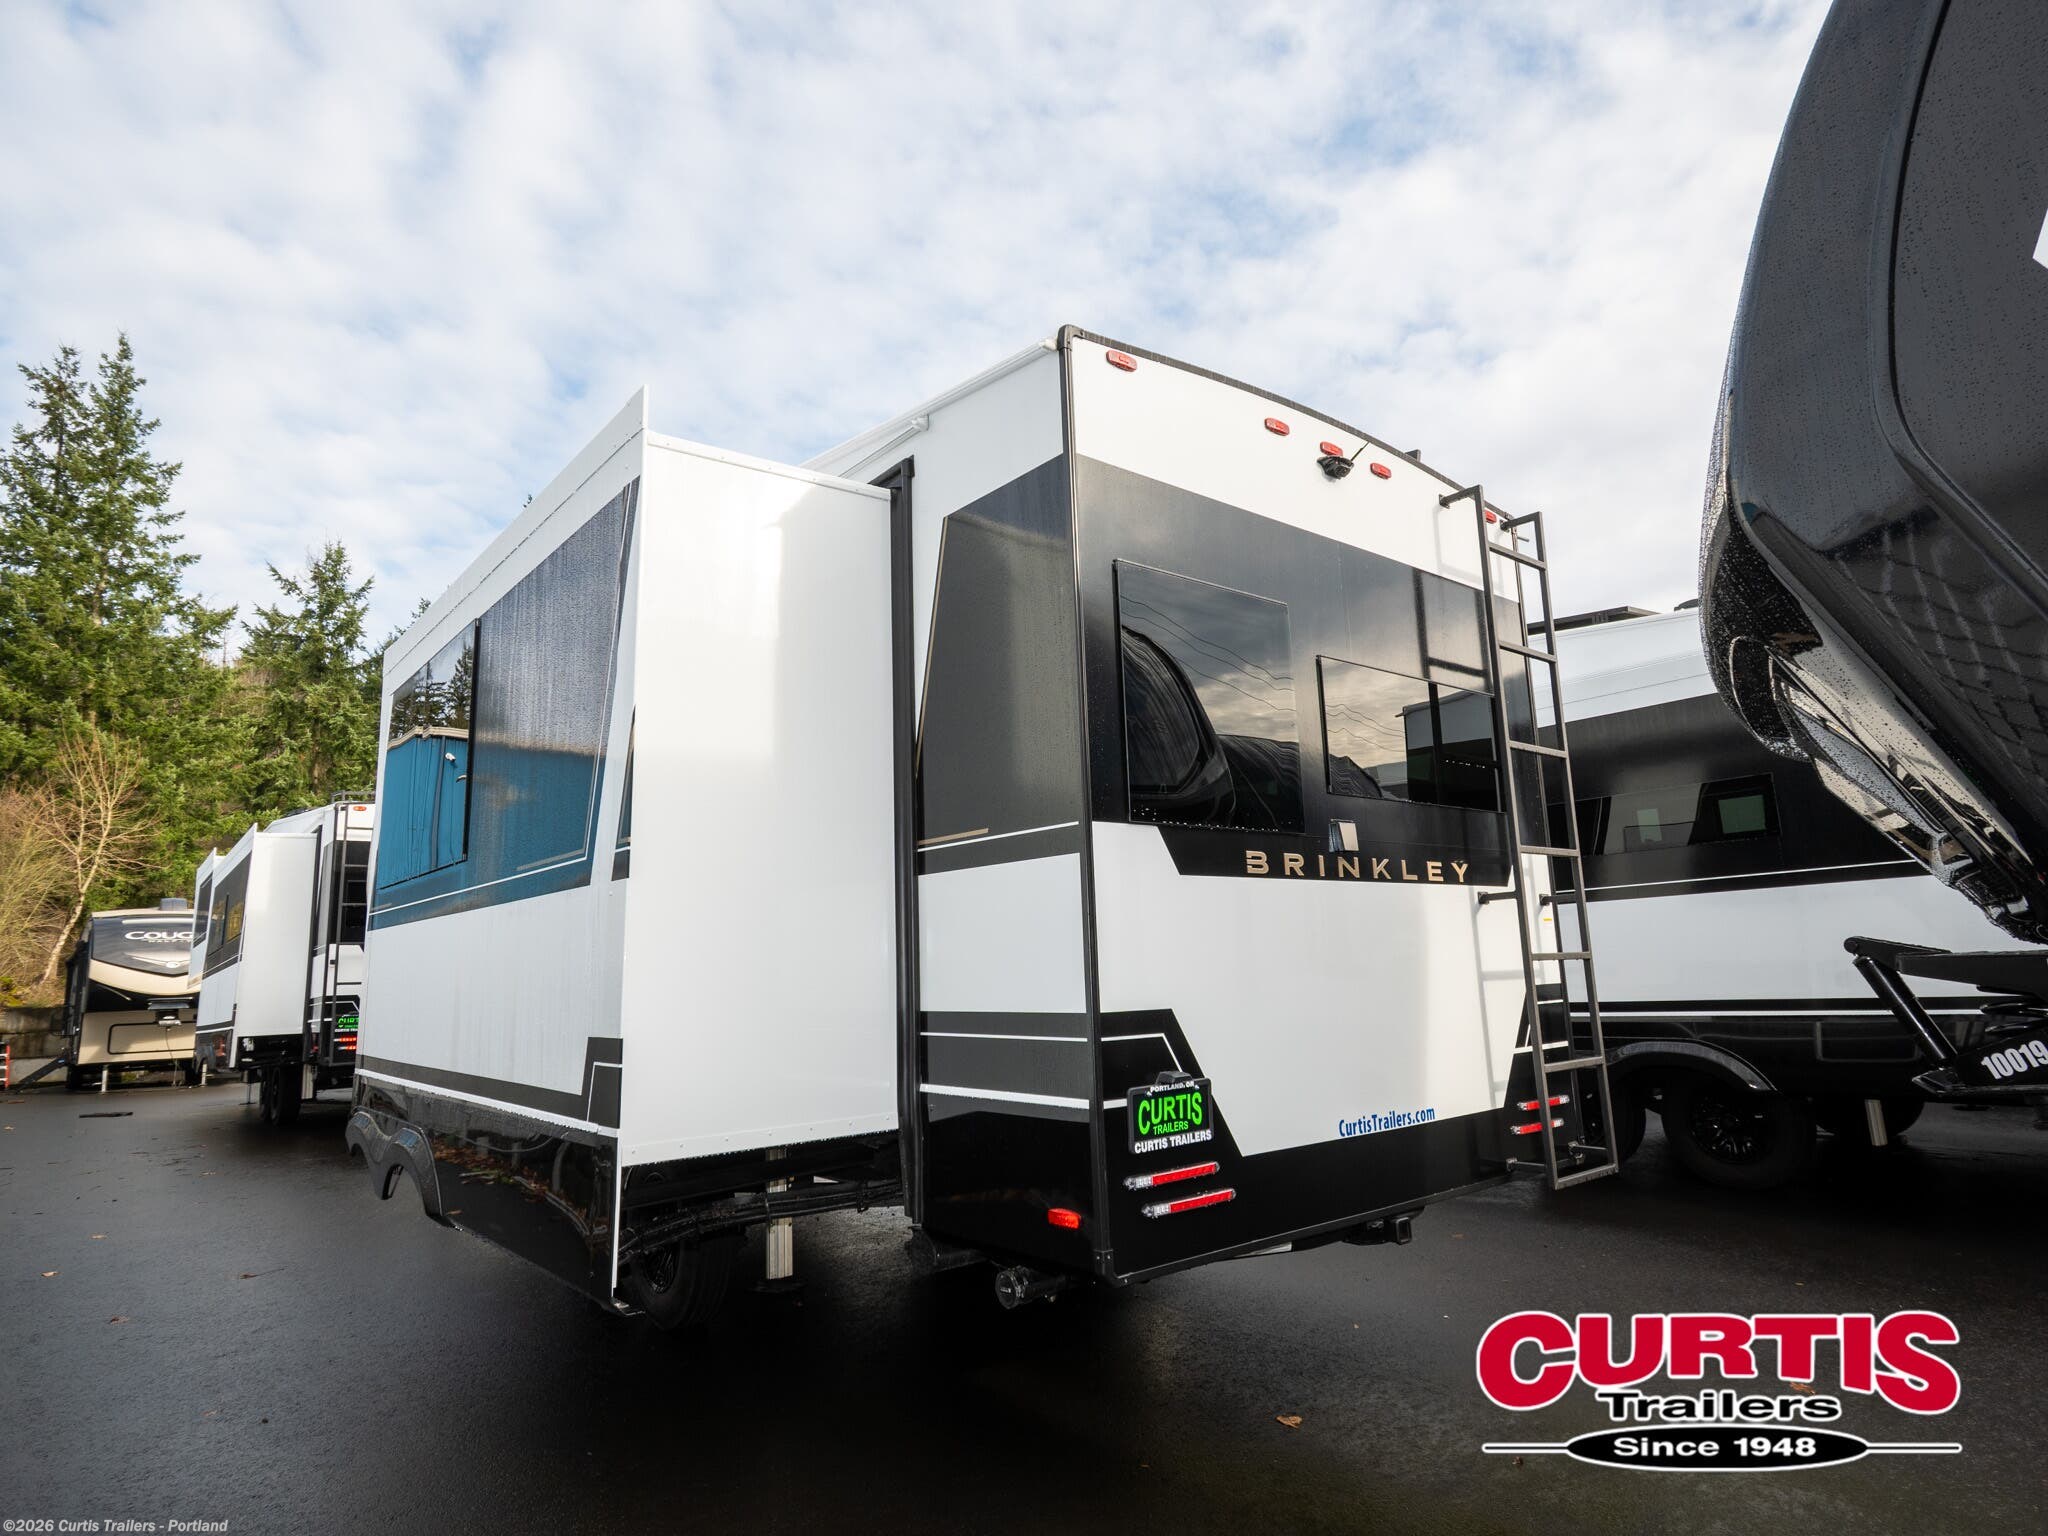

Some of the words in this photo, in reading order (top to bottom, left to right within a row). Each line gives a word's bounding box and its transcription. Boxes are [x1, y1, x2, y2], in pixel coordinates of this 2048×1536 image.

[1246, 850, 1469, 883] BRINKLEY
[1138, 1092, 1202, 1135] CURTIS
[1153, 1121, 1188, 1135] TRAILERS
[1339, 1107, 1435, 1137] CurtisTrailers.com
[1134, 1138, 1168, 1154] CURTIS
[1170, 1129, 1212, 1148] TRAILERS
